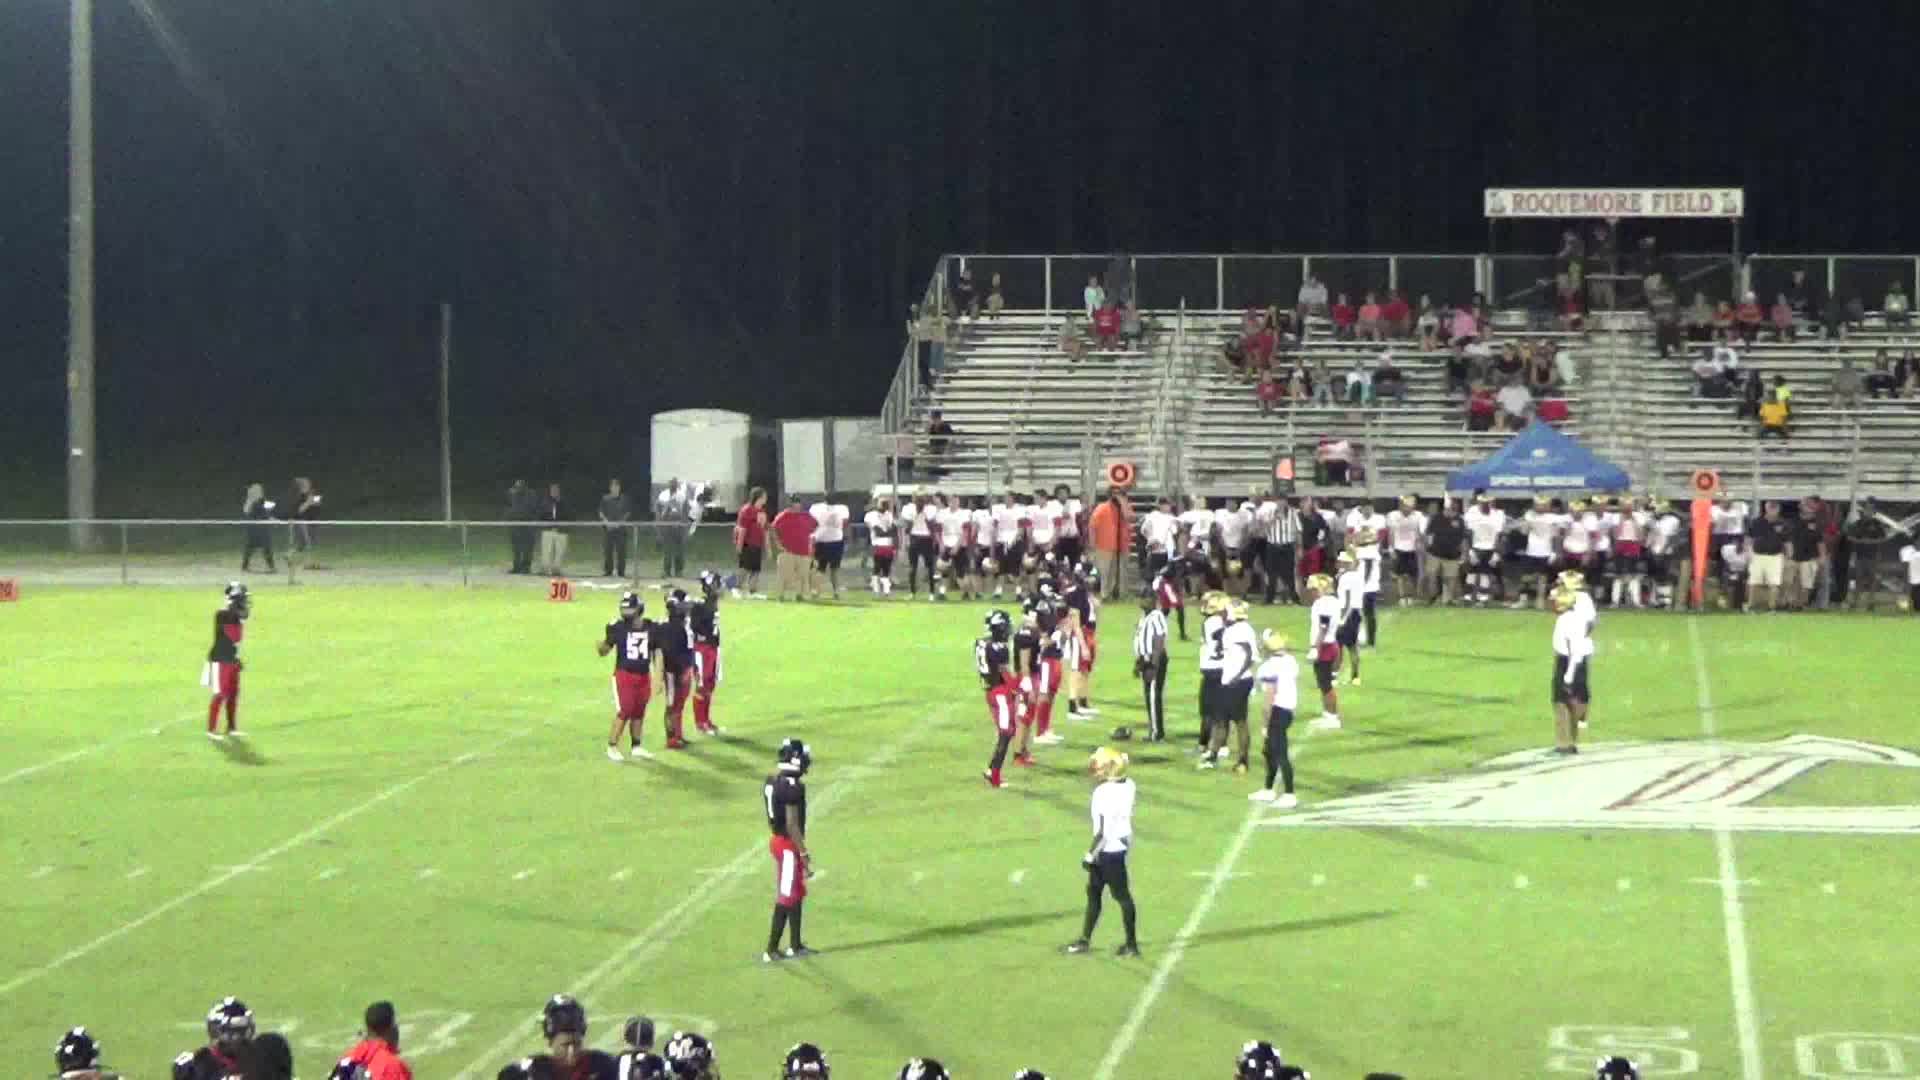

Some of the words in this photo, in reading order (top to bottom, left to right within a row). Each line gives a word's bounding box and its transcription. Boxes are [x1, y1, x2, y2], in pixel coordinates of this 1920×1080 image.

[1511, 192, 1642, 213] ROQUEMORE
[1651, 192, 1713, 213] FIELD
[551, 582, 568, 599] 30
[626, 631, 648, 659] 54
